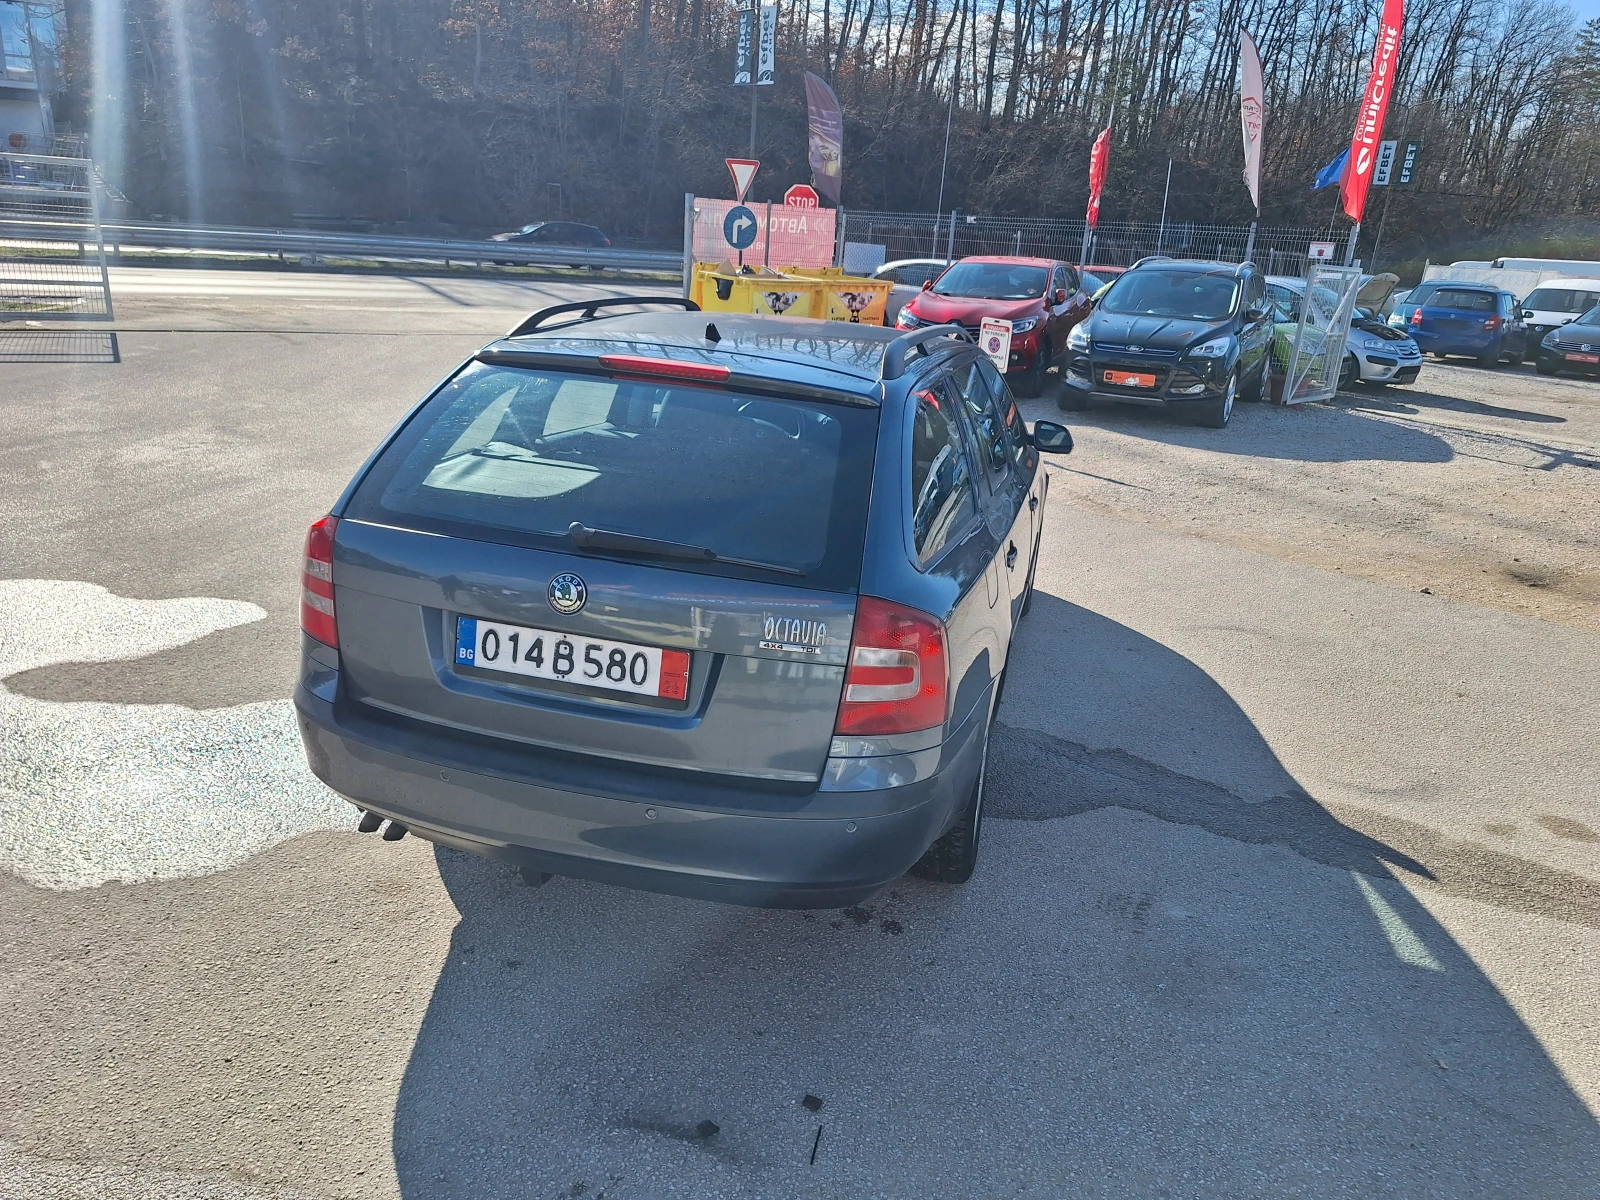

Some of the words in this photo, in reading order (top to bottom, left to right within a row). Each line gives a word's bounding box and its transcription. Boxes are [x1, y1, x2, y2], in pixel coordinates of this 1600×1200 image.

[736, 14, 748, 68] efbet
[761, 11, 770, 66] efbet
[1377, 143, 1393, 183] EFBET
[1400, 143, 1417, 183] EFBET
[788, 196, 815, 208] STOP
[764, 616, 827, 646] OCTAVIA
[459, 647, 474, 660] BG
